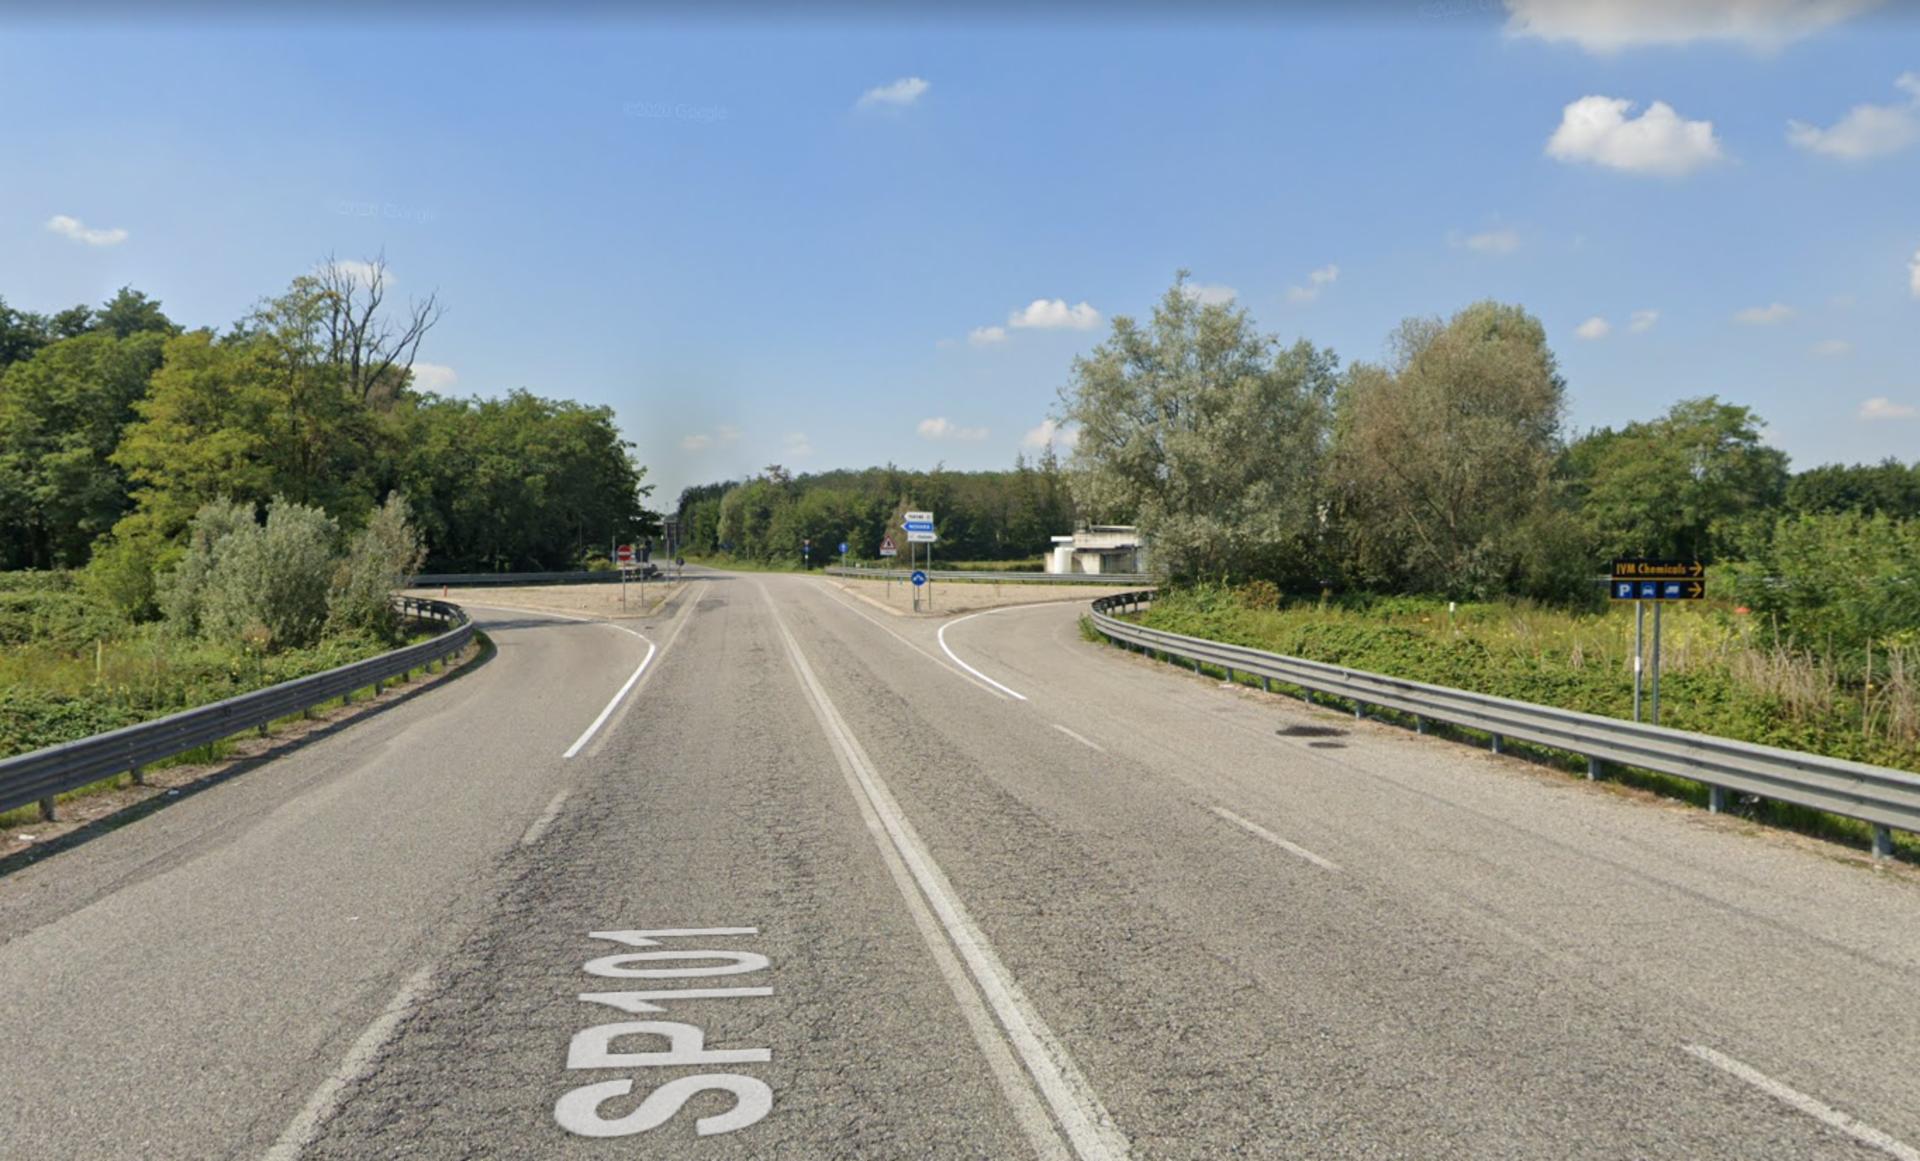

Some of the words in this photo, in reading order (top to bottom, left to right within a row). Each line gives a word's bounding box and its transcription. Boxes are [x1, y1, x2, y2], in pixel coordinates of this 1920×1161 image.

[1638, 562, 1686, 575] Chemicals
[1619, 584, 1631, 597] P
[554, 927, 774, 1138] SP101
